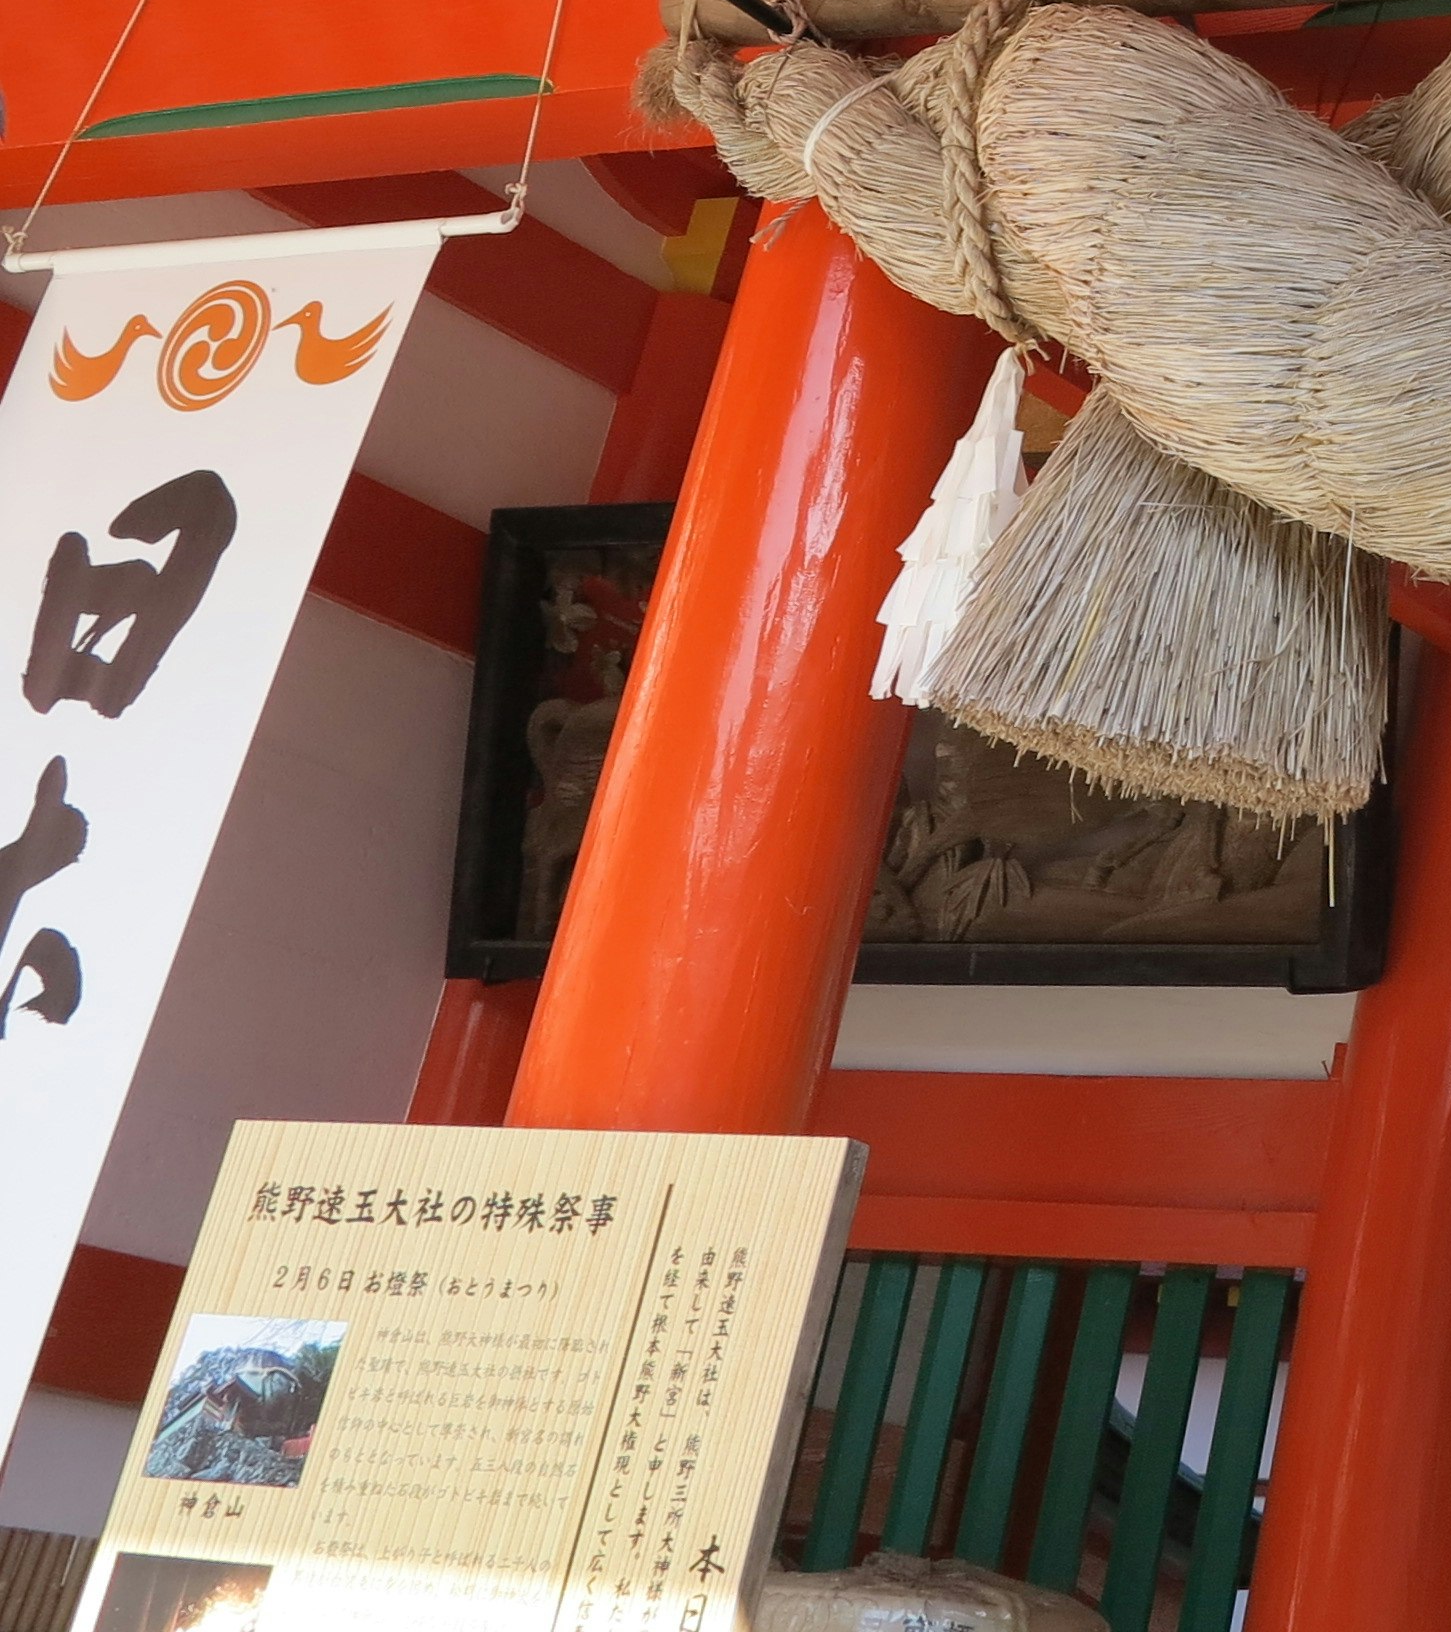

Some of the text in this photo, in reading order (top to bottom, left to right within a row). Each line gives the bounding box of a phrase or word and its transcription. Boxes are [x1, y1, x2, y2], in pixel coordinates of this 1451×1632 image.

[247, 1181, 618, 1235] 熊野速玉大社の特殊祭事
[179, 1491, 245, 1519] 神倉山
